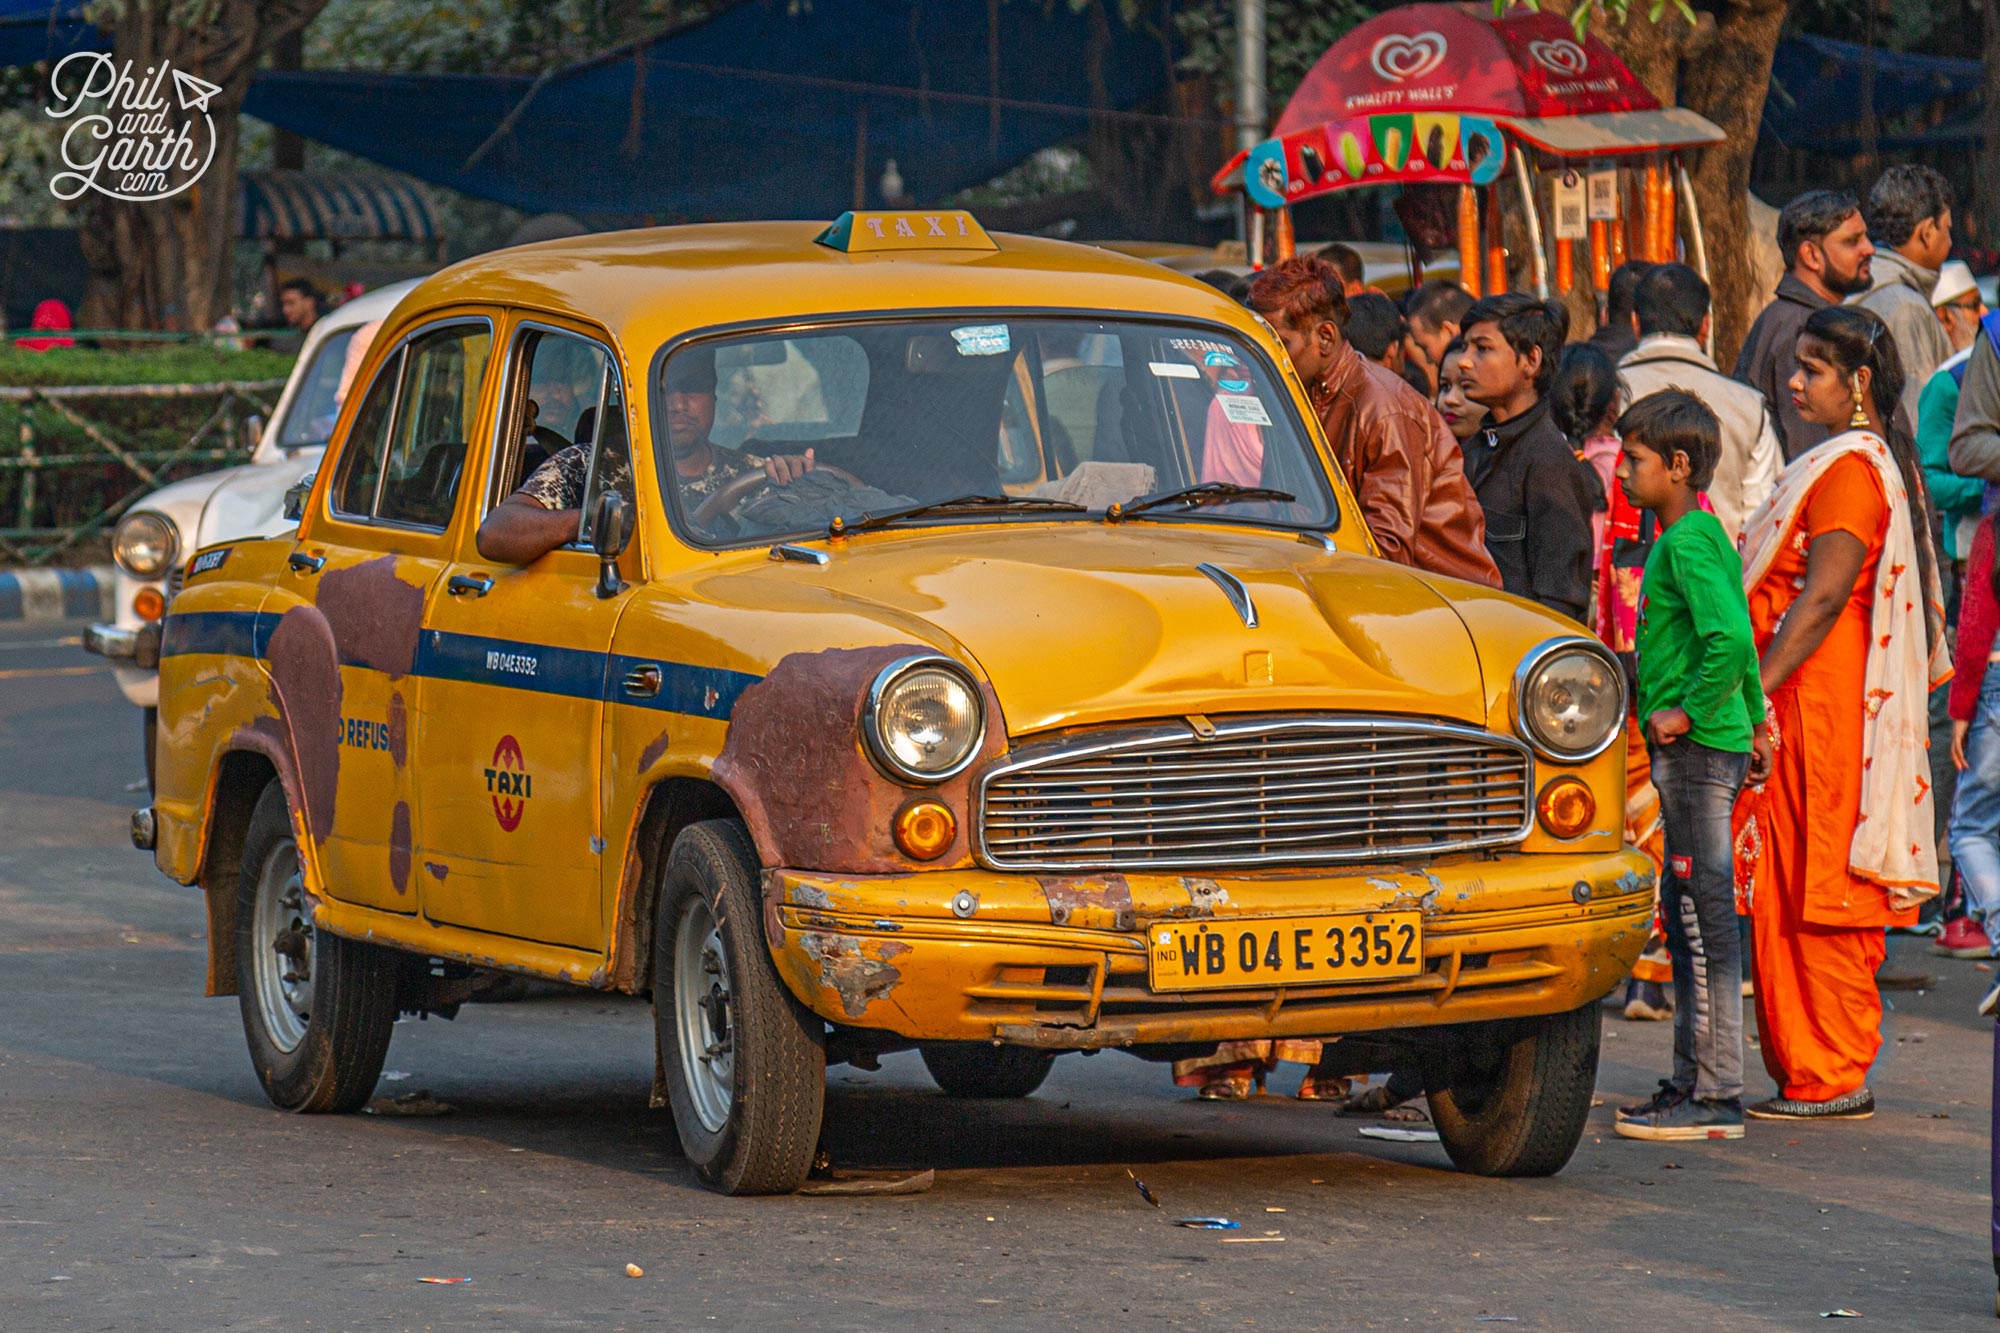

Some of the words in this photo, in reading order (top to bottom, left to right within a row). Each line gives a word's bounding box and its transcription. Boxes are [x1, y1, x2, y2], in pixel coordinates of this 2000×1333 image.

[865, 215, 969, 238] TAXI
[484, 768, 531, 799] TAXI
[1157, 949, 1177, 962] IND
[1179, 933, 1225, 976] WB
[1238, 930, 1283, 972] 04
[1295, 929, 1314, 971] E
[1325, 923, 1416, 969] 3352
